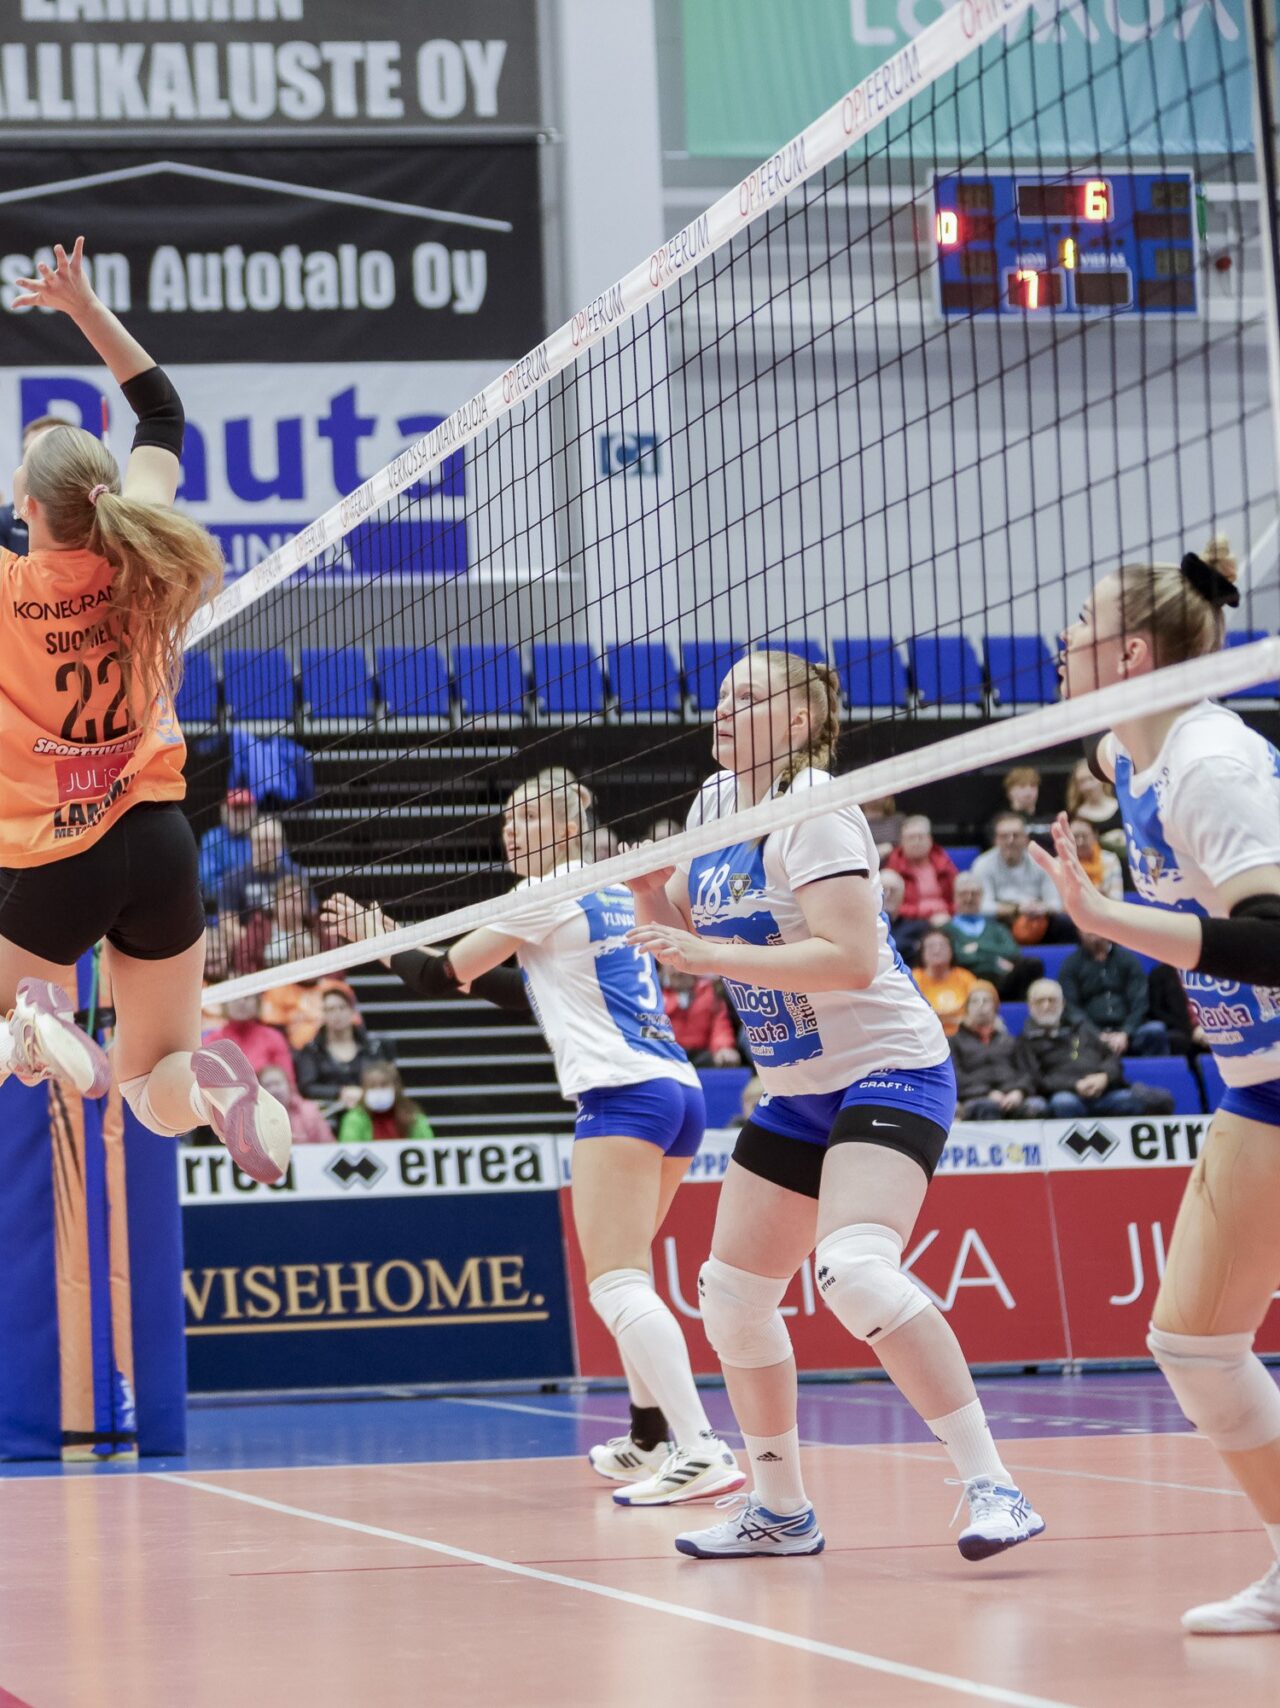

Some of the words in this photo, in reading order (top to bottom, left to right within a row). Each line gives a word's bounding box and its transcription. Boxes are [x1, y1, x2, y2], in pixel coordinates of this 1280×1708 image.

[418, 38, 508, 120] OY
[842, 43, 922, 135] OPIFERUM
[739, 136, 808, 216] OPIFERUM
[1085, 181, 1108, 220] 6
[148, 244, 396, 313] Autotalo
[412, 241, 488, 314] Oy
[649, 212, 710, 287] OPIFERUM
[570, 281, 626, 347] OPIFERUM
[502, 342, 550, 404] OPIFERUM
[55, 651, 136, 744] 22
[697, 863, 731, 916] 18
[633, 945, 658, 1011] 3
[748, 1022, 788, 1042] auta
[859, 1081, 903, 1089] CRAFT
[1130, 1122, 1204, 1161] err
